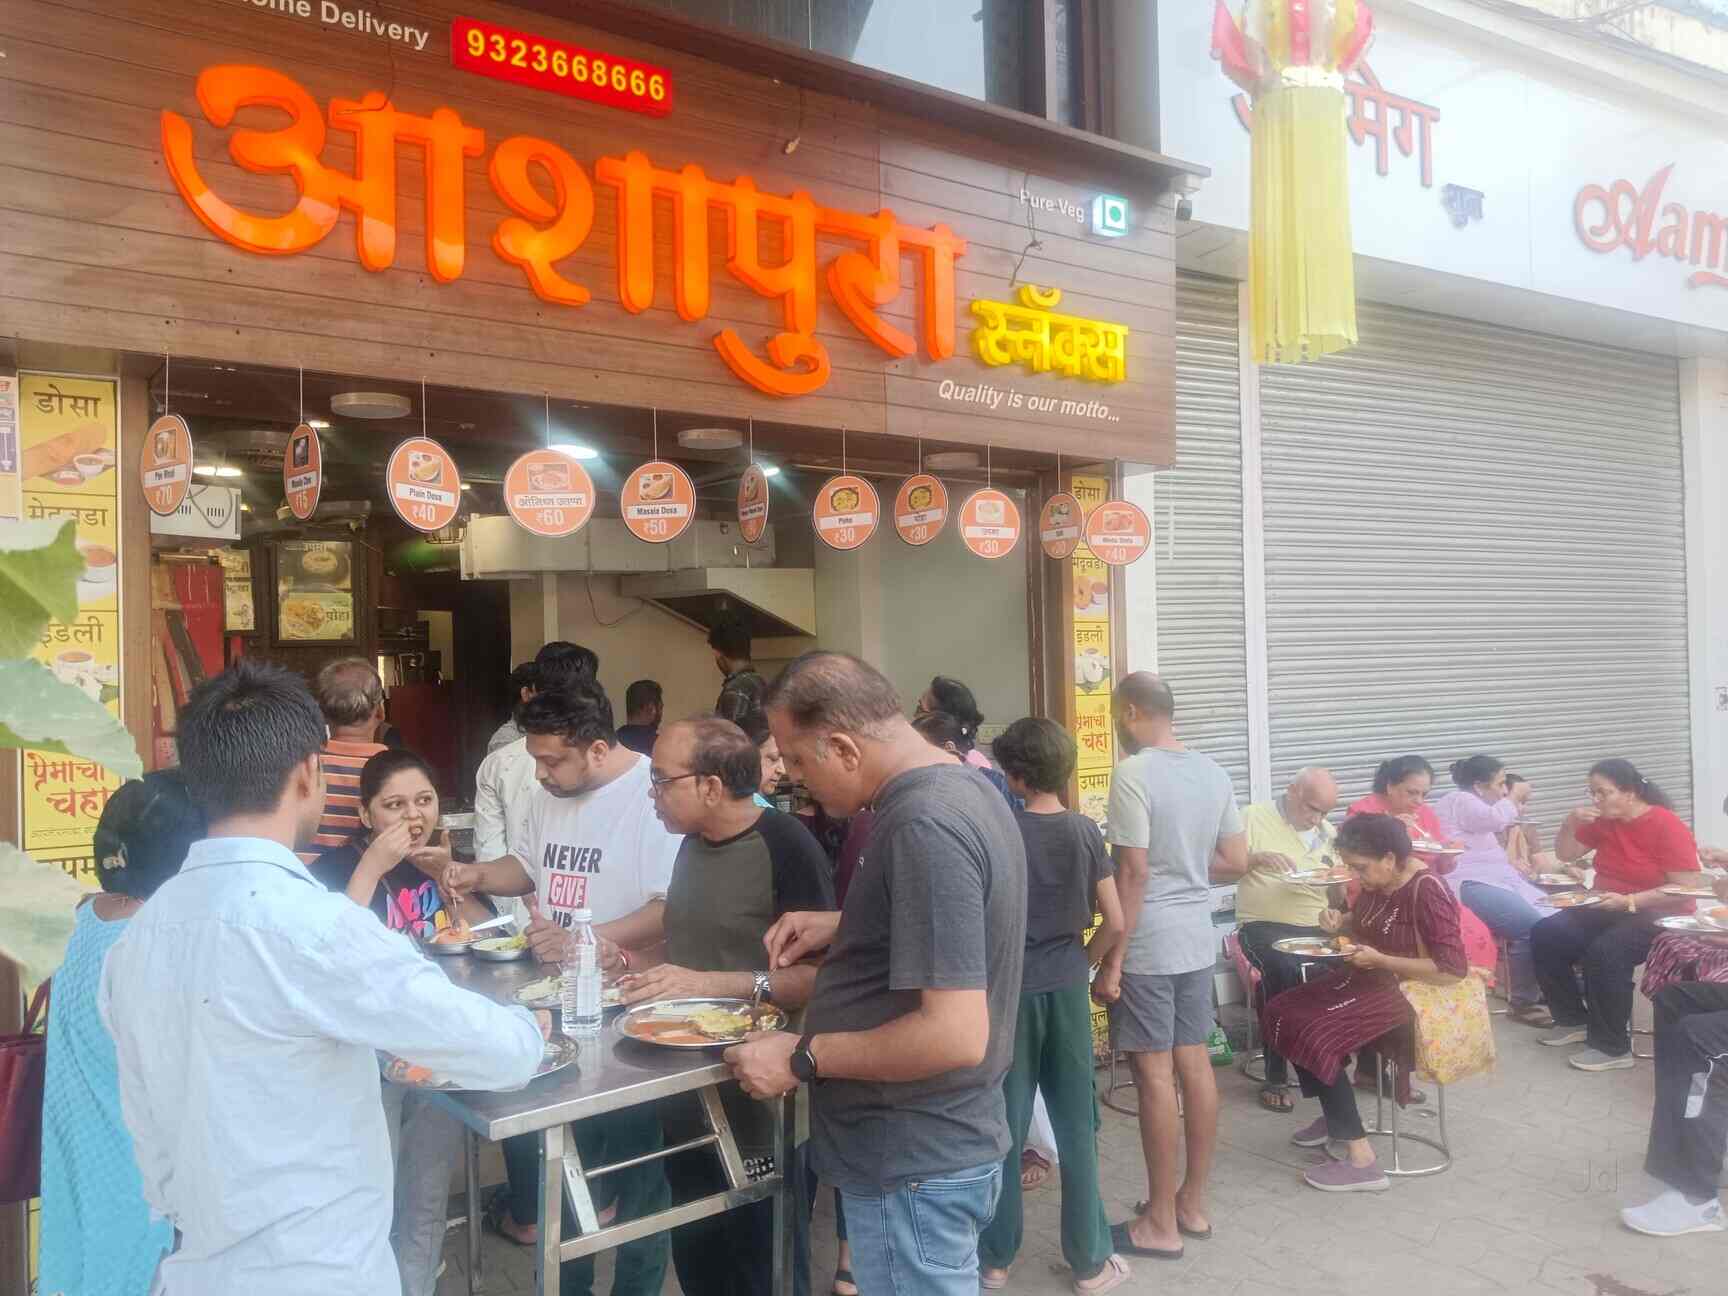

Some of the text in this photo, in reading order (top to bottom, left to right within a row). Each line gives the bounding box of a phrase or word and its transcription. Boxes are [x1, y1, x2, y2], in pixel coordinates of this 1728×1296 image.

[320, 1, 429, 50] Delivery
[466, 28, 667, 102] 9323668666
[1019, 188, 1086, 224] Pure Veg
[161, 63, 968, 397] आशापुरा
[33, 384, 101, 419] डोसा
[937, 379, 1120, 423] Quality is our motto...
[426, 490, 443, 502] Dosa
[661, 506, 677, 515] Dosa
[536, 509, 565, 526] ₹60
[1079, 773, 1109, 790] उपमा
[543, 842, 602, 873] NEVER
[551, 875, 585, 907] GIVE
